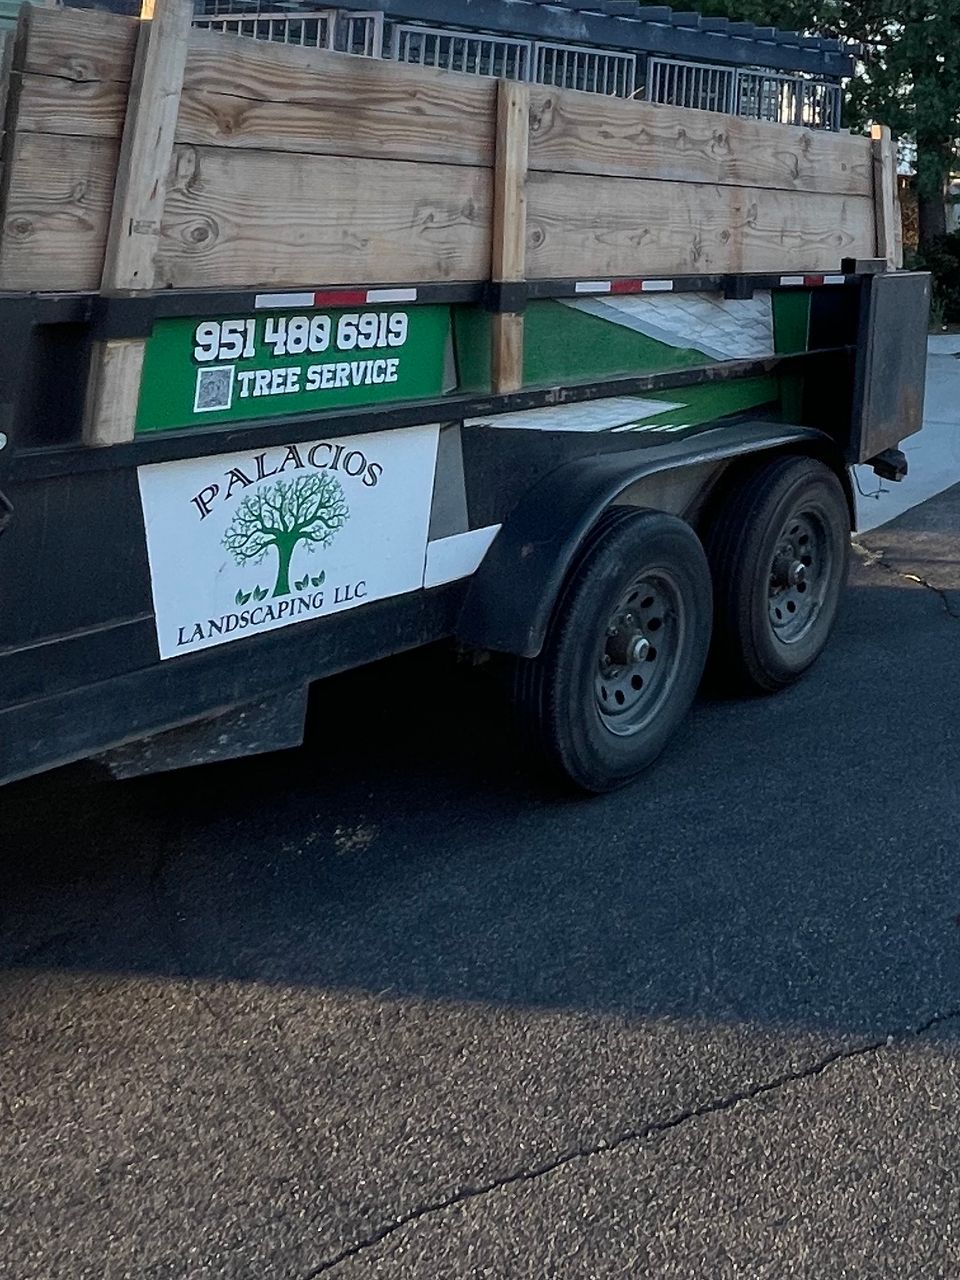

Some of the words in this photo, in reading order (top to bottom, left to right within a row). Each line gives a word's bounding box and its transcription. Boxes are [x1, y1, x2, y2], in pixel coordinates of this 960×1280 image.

[194, 319, 256, 361] 951
[336, 312, 409, 350] 6919
[237, 367, 301, 398] TREE
[305, 358, 400, 391] SERVICE
[190, 443, 384, 521] PALACIOS
[177, 592, 324, 646] LANDSCAPING
[333, 581, 368, 604] LLC
